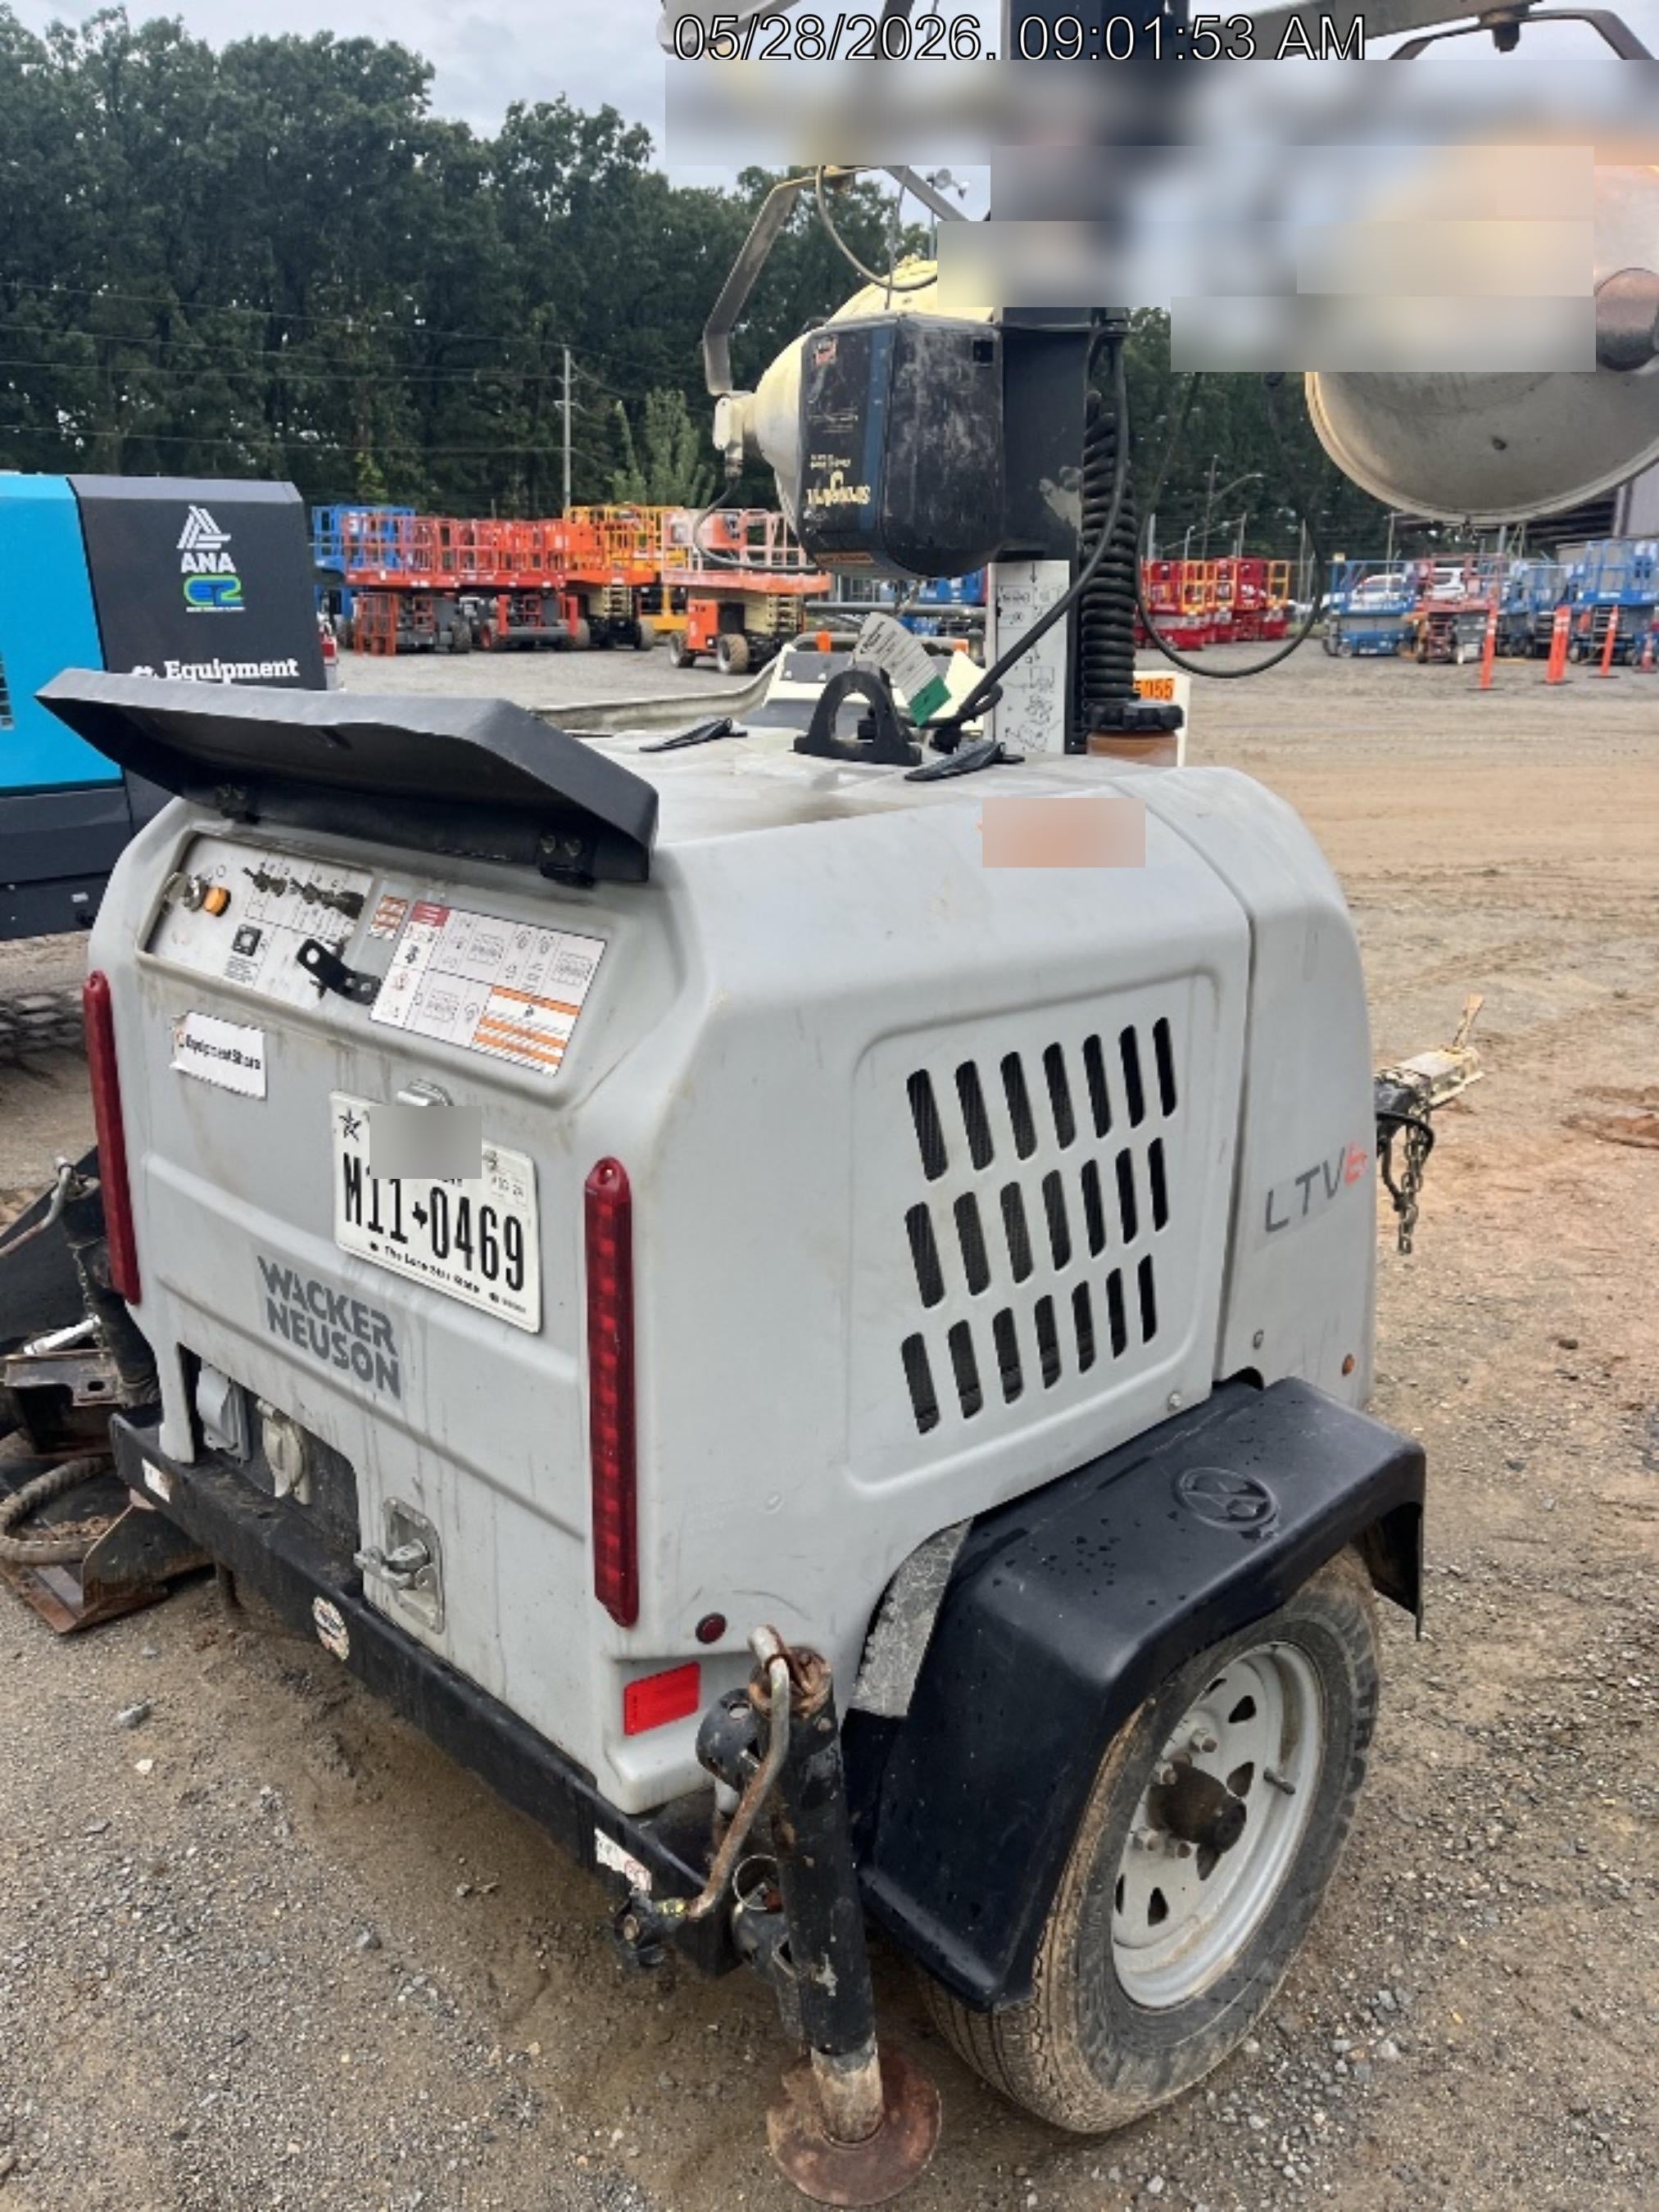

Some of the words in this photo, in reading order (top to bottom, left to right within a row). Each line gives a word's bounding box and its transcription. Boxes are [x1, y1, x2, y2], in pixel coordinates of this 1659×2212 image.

[180, 552, 237, 573] ANA
[164, 658, 300, 684] Equipment
[343, 1152, 408, 1244] M11
[429, 1185, 525, 1292] 0469
[257, 1255, 398, 1357] WACKER
[266, 1297, 401, 1400] NEUSON
